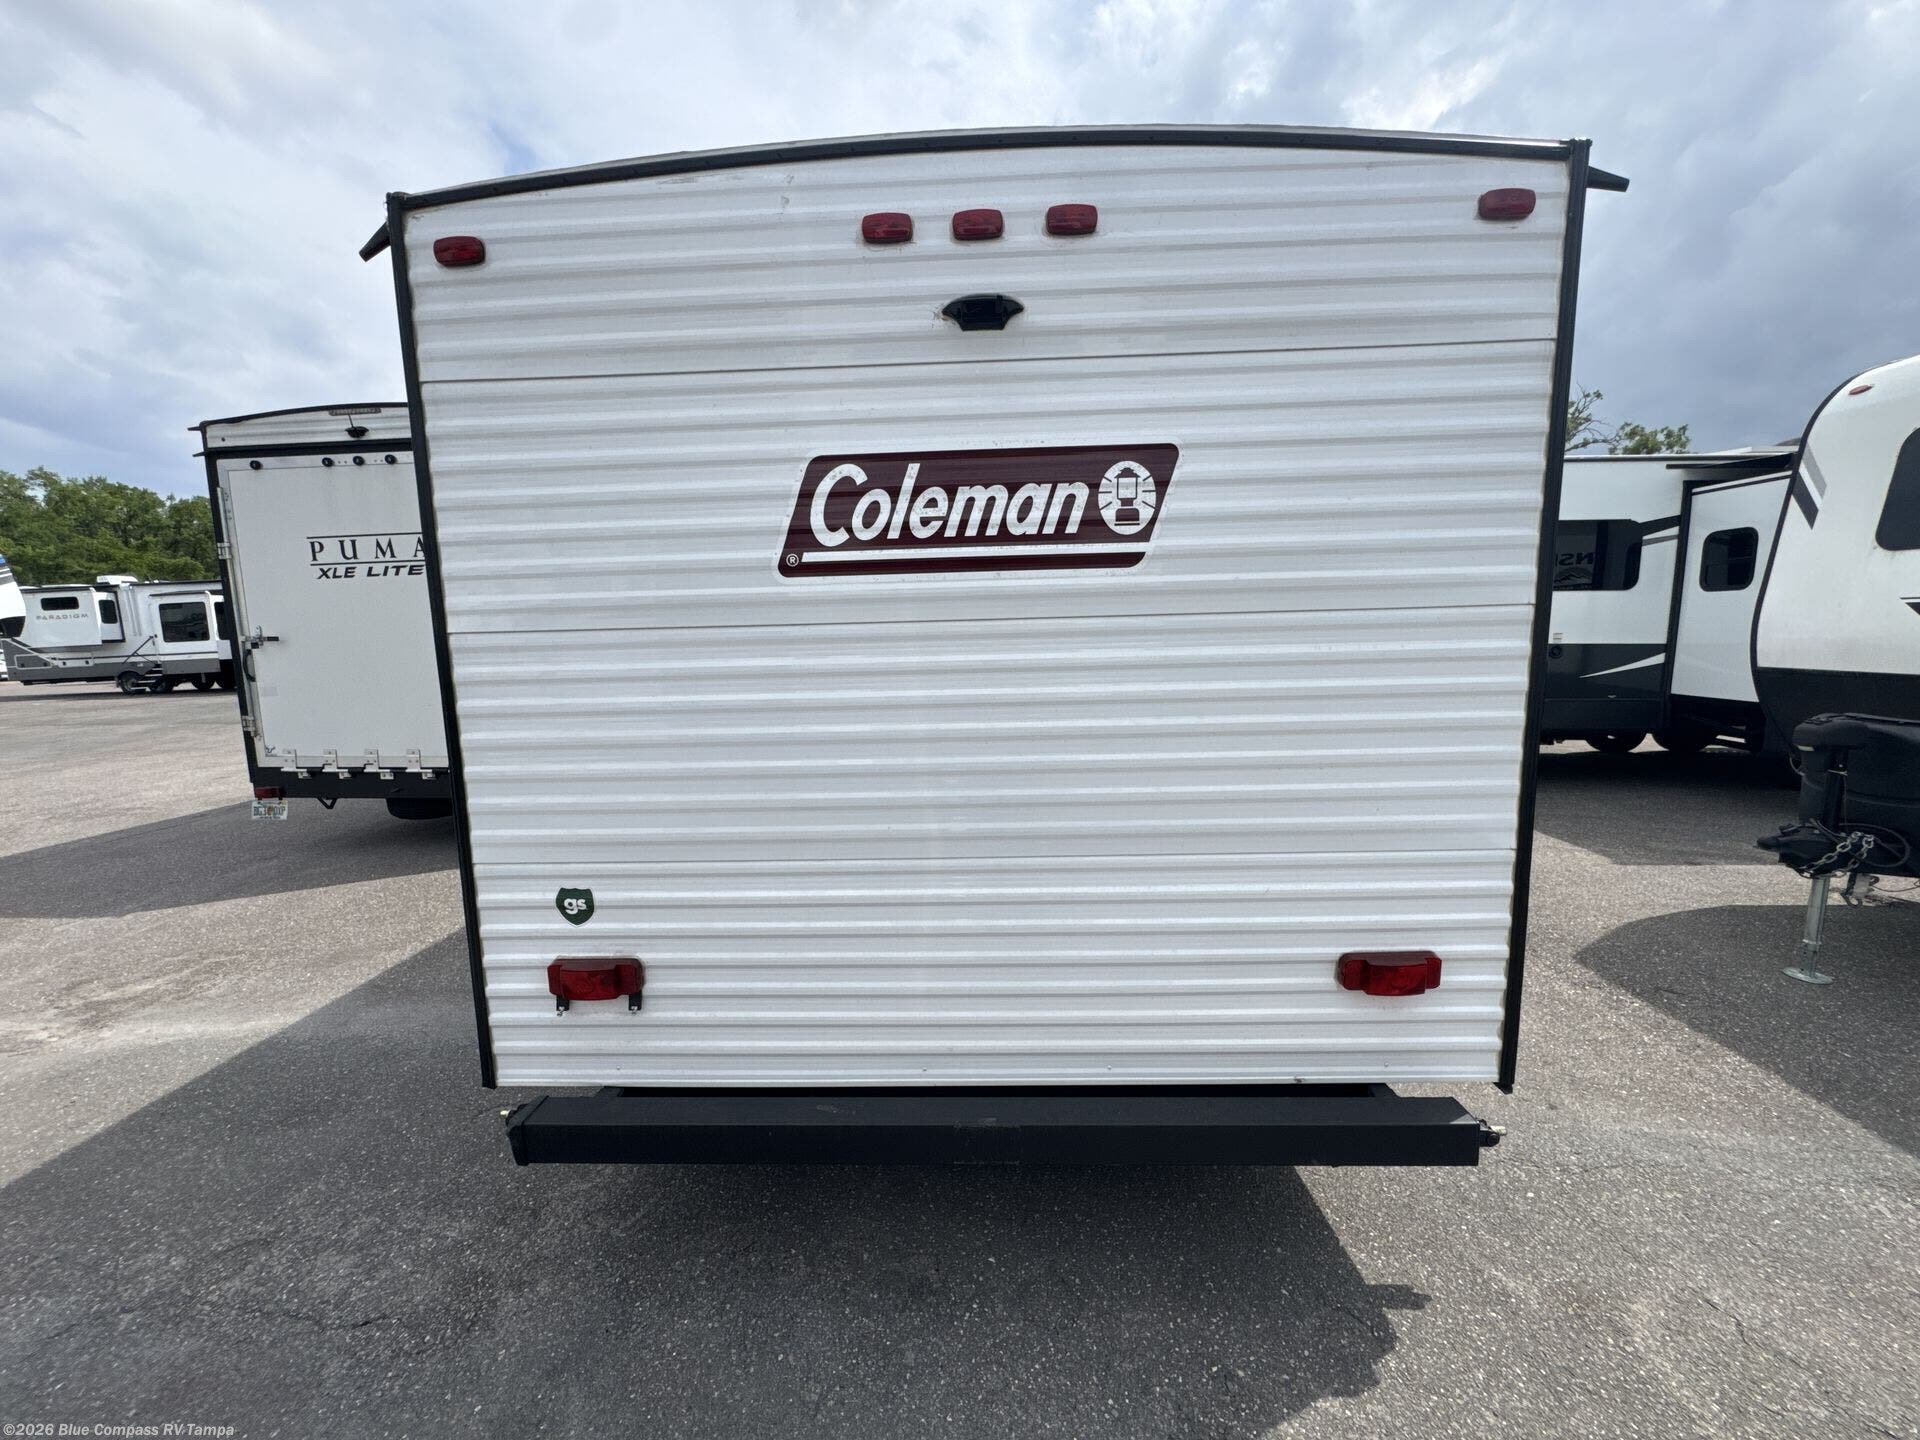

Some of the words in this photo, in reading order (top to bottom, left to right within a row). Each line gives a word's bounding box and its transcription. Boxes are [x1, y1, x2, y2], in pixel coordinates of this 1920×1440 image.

[810, 463, 1091, 547] Coleman
[309, 537, 425, 561] PUMA
[317, 567, 357, 579] XLE
[367, 564, 425, 577] LITE
[564, 898, 587, 915] gs
